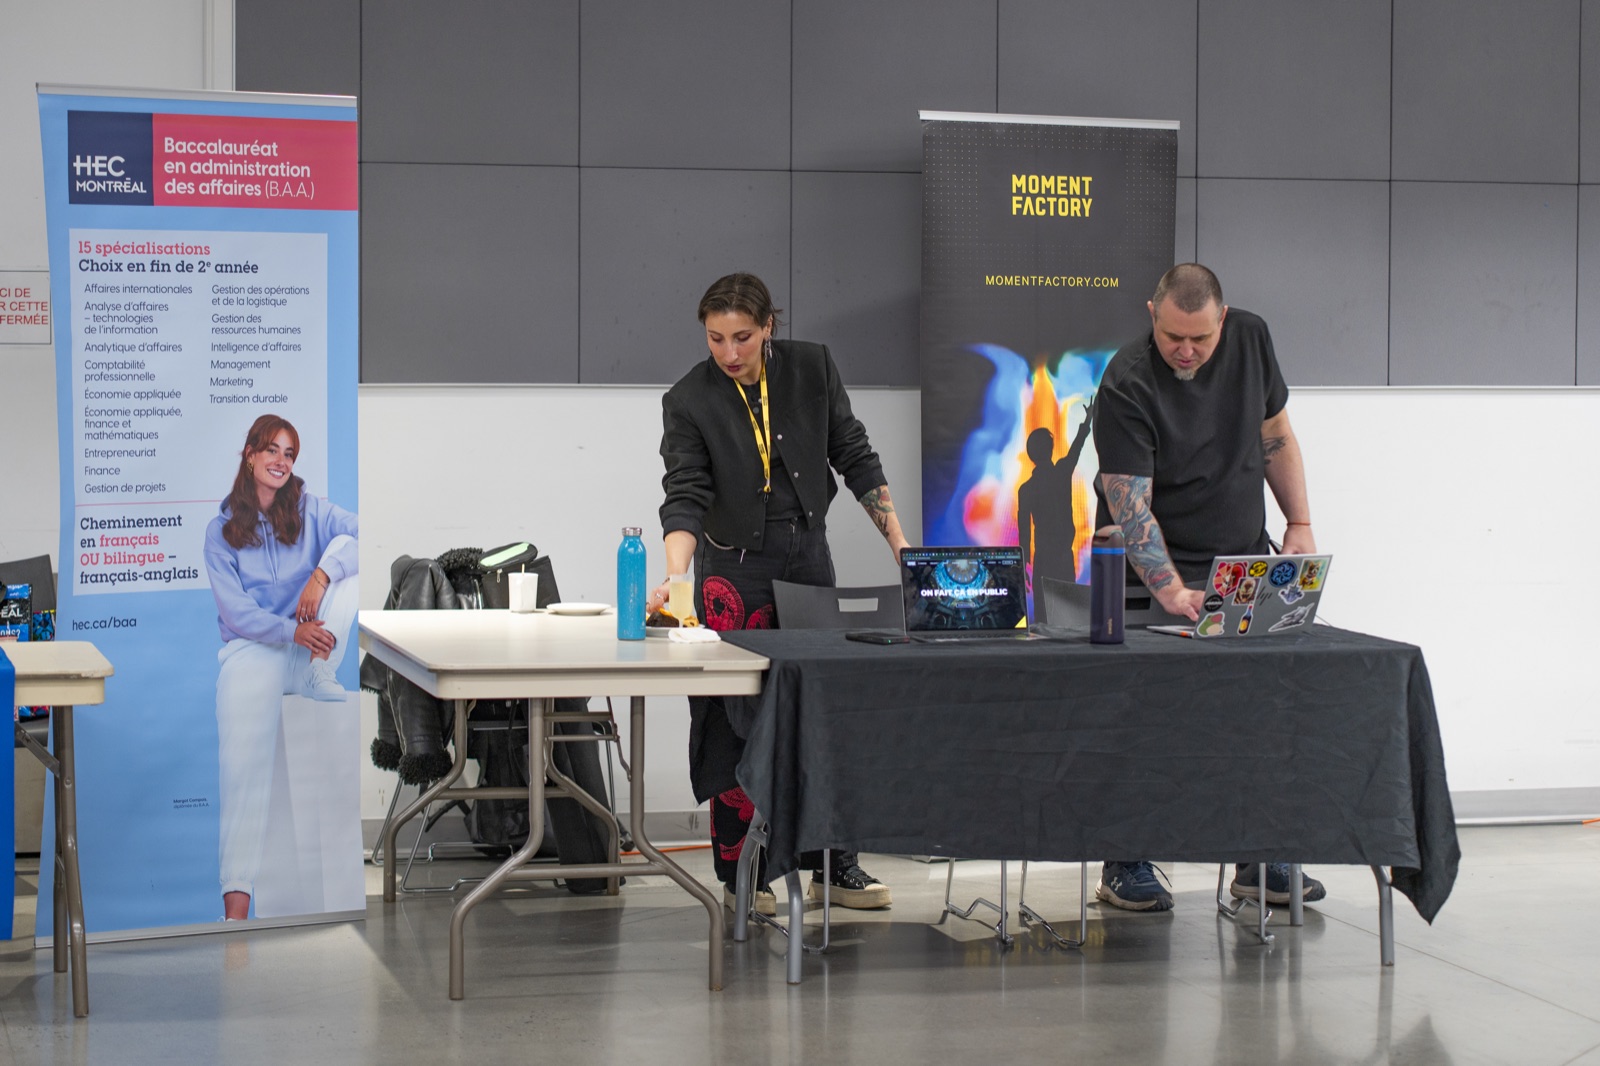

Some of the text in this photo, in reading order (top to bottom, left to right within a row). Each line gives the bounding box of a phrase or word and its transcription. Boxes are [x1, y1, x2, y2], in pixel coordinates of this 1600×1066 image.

[164, 137, 278, 156] Baccalauréat
[73, 155, 125, 177] HEC
[164, 159, 311, 178] en administration
[164, 178, 315, 200] des affaires (B.A.A.)
[1012, 174, 1092, 195] MOMENT
[1012, 196, 1092, 217] FACTORY
[79, 241, 210, 257] 15 spécialisations
[79, 259, 123, 272] Choix
[127, 262, 146, 272] en
[150, 260, 171, 272] fin
[175, 260, 194, 273] de
[214, 260, 259, 273] année
[985, 275, 1119, 287] MOMENTFACTORY.COM
[14, 288, 31, 298] DE
[84, 284, 193, 294] Affaires internationales
[212, 285, 309, 296] Gestion des opérations
[9, 301, 48, 312] CETTE
[84, 301, 121, 312] Analyse
[212, 297, 287, 308] et de la logistique
[93, 314, 153, 325] technologies
[212, 313, 262, 323] Gestion des
[84, 325, 97, 334] de
[212, 325, 301, 334] ressources humaines
[84, 342, 136, 353] Analytique
[211, 342, 259, 354] Intelligence
[84, 360, 145, 371] Comptabilité
[210, 360, 271, 371] Management
[84, 371, 155, 383] professionnelle
[210, 377, 254, 388] Marketing
[84, 387, 182, 400] Économie appliquée
[209, 394, 288, 403] Transition durable
[84, 405, 182, 418] Économie appliquée,
[84, 419, 131, 428] finance et
[84, 430, 159, 441] mathématiques
[84, 448, 156, 459] Entrepreneuriat
[84, 466, 120, 475] Finance
[84, 482, 166, 494] Gestion de projets
[80, 515, 182, 530] Cheminement
[80, 533, 160, 549] en français
[80, 553, 100, 566] OU
[103, 551, 165, 567] bilingue
[80, 566, 199, 586] français-anglais
[920, 589, 934, 597] ON
[935, 589, 952, 597] FAIT
[979, 588, 1008, 596] PUBLIC
[72, 616, 137, 631] hec.ca/baa
